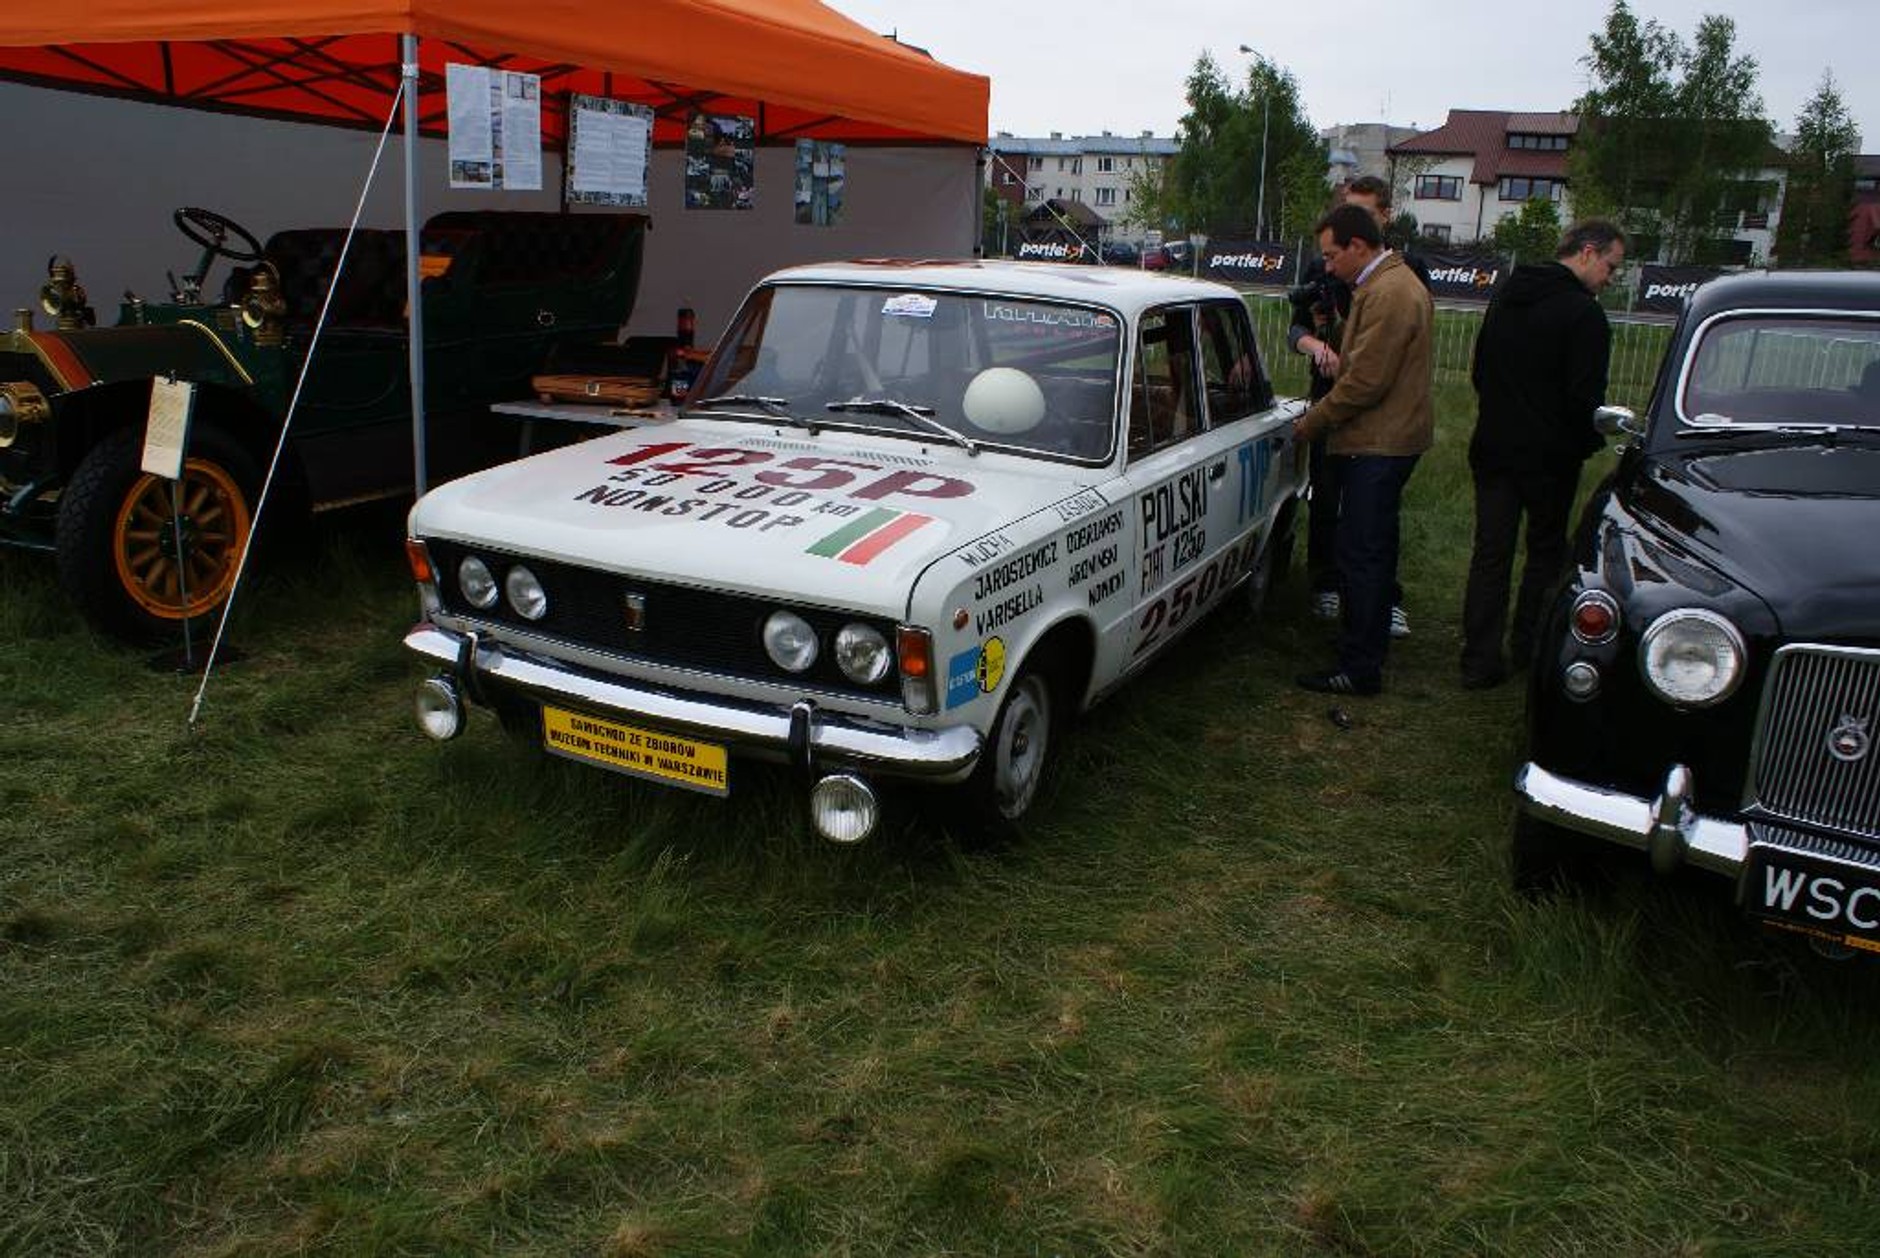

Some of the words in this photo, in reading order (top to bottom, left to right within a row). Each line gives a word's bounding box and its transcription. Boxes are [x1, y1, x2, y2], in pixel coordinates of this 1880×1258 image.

[574, 485, 804, 532] NONSTOP
[1141, 466, 1207, 550] POLSKI
[957, 534, 1016, 568] MUCHA
[974, 539, 1058, 601] JAROSZEWICZ
[976, 583, 1044, 637] VARISELLA
[593, 741, 640, 763] TECHNIKI
[657, 757, 725, 782] WARSZAWIE
[629, 732, 642, 747] ZE
[1766, 865, 1880, 929] WSC
